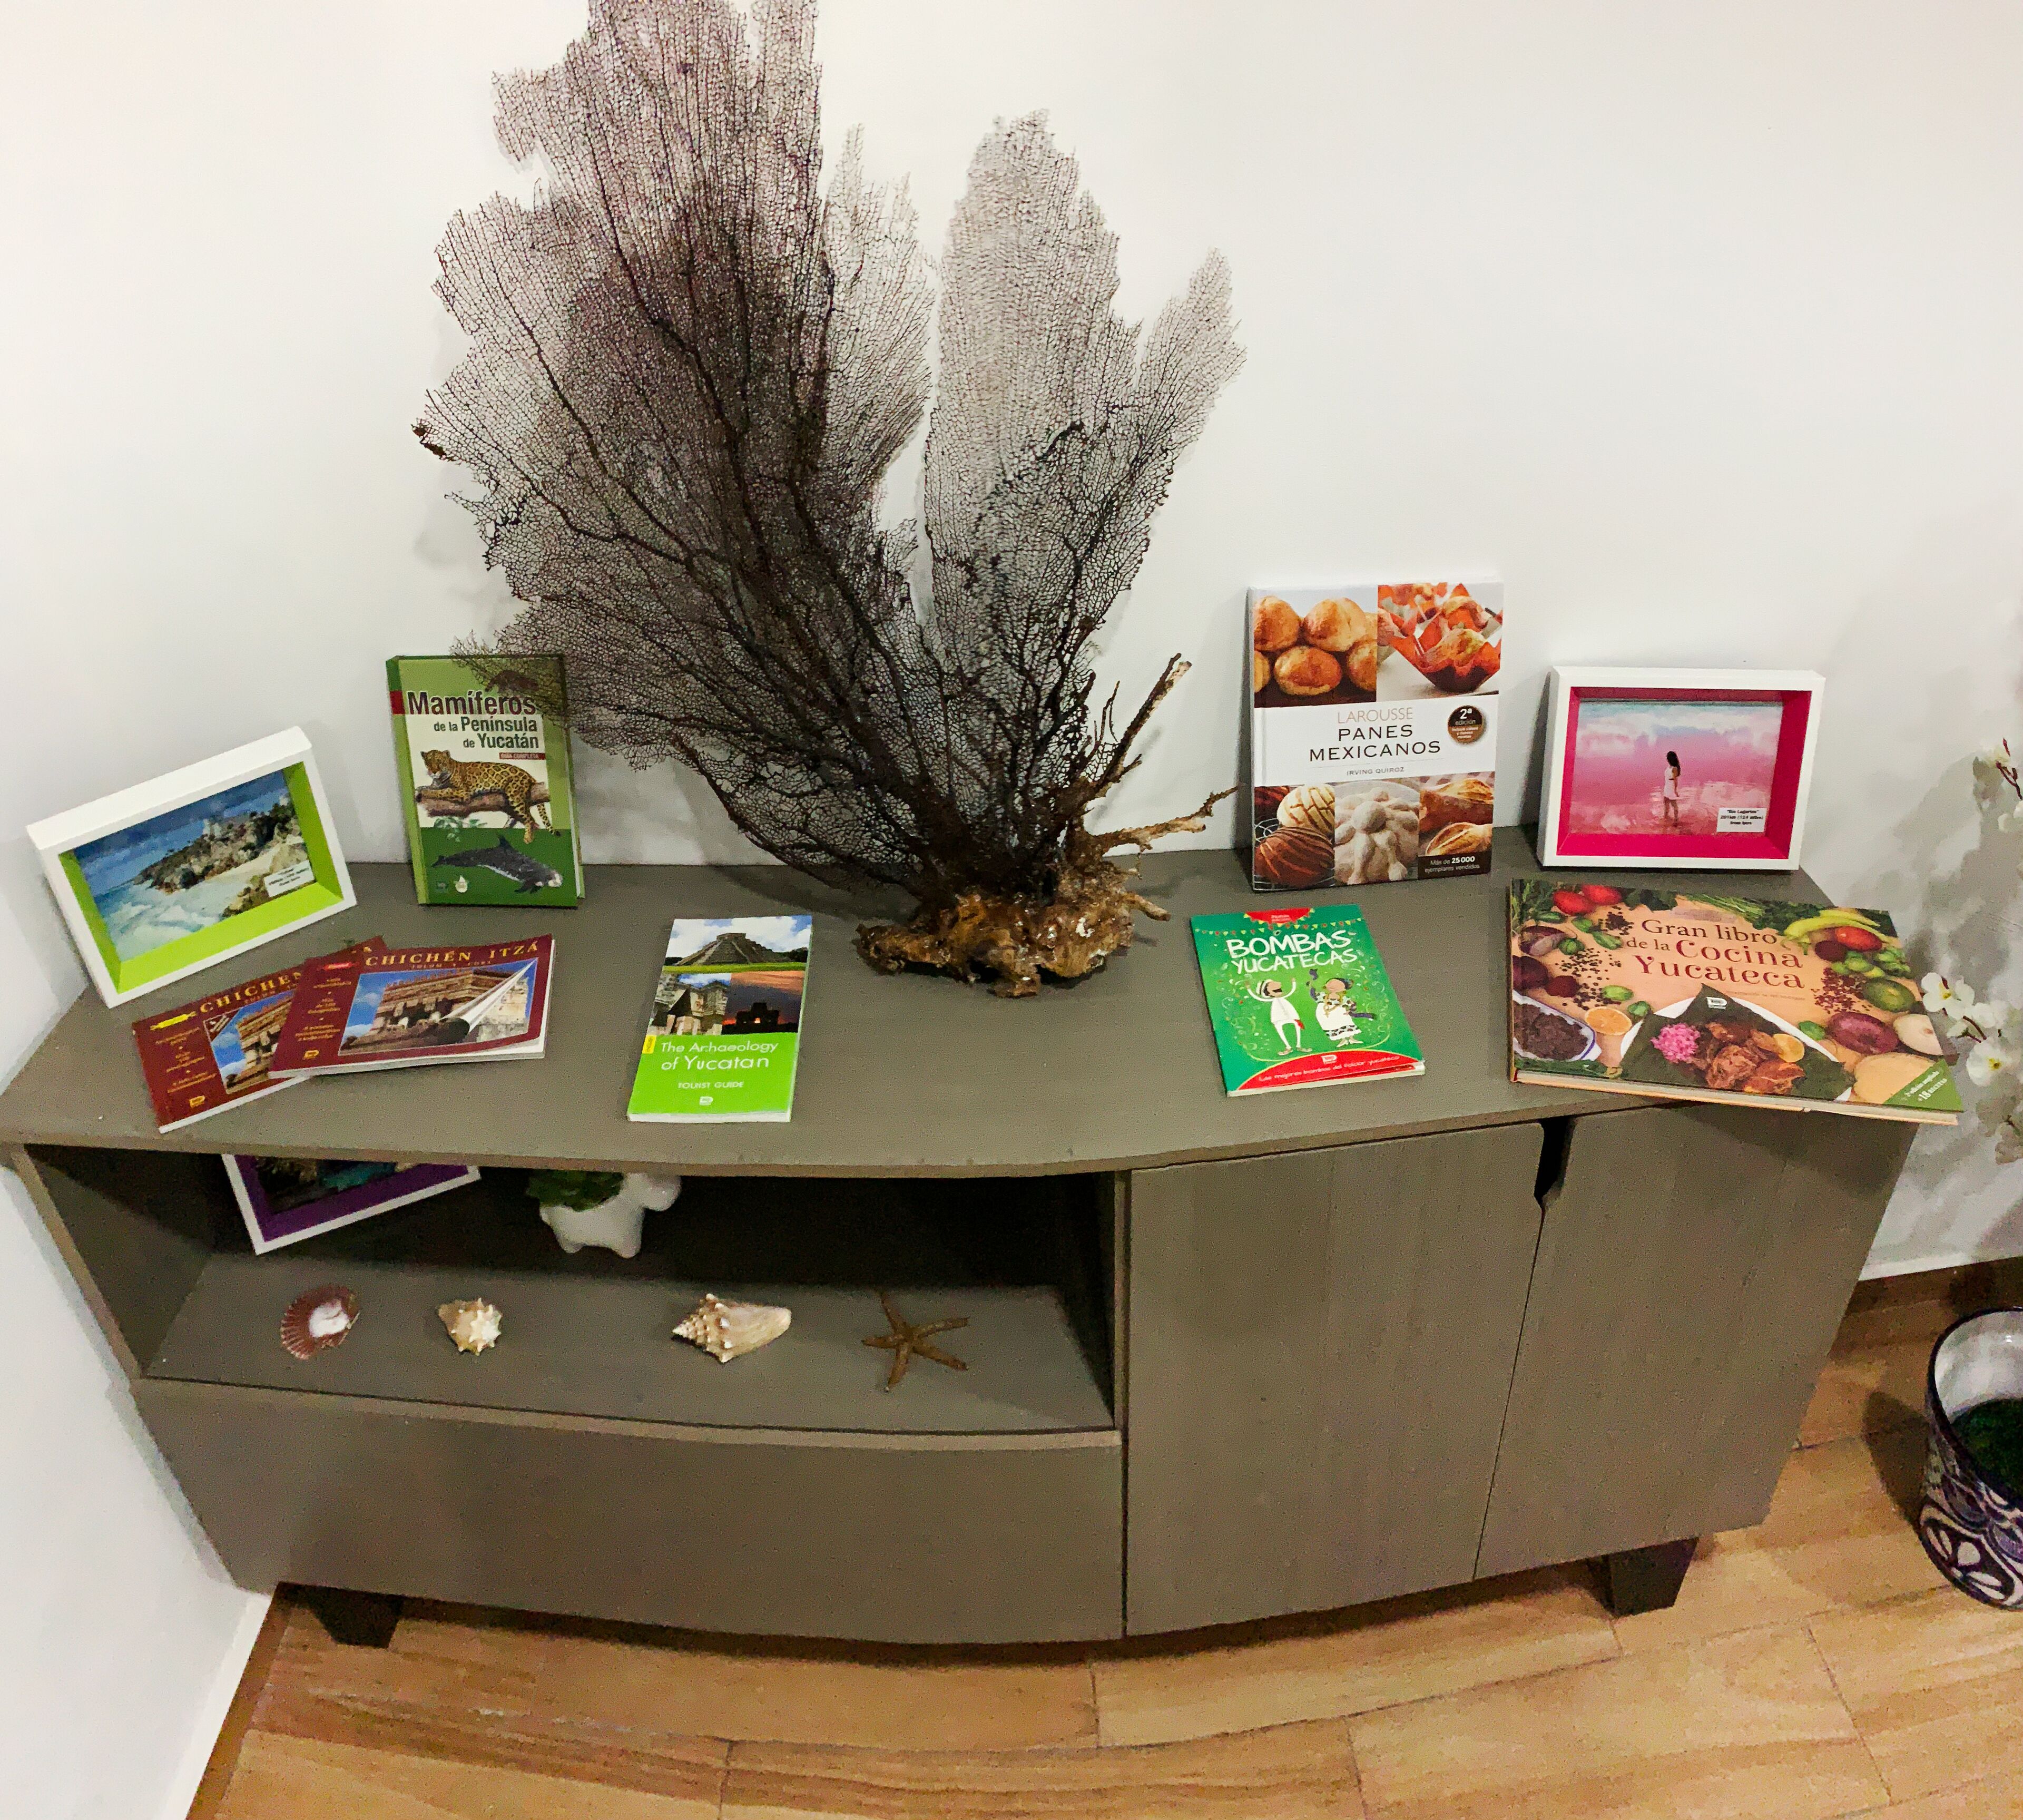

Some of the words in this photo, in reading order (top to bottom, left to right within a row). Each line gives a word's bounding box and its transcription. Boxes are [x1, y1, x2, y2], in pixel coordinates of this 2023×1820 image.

[407, 690, 536, 715] Mamíferos
[434, 721, 446, 731] de
[449, 721, 458, 731] la
[460, 716, 538, 732] Península
[1338, 707, 1413, 723] LAROUSSE
[463, 738, 474, 748] de
[477, 731, 539, 749] Yucatán
[1338, 725, 1413, 741] PANES
[1310, 741, 1440, 762] MEXICANOS
[1642, 919, 1708, 938] Gran
[1715, 925, 1777, 944] libro
[1226, 930, 1351, 958] BOMBAS
[1626, 937, 1647, 949] de
[1654, 939, 1671, 951] la
[1675, 940, 1803, 968] Cocina
[1231, 948, 1357, 974] YUCATECAS
[1634, 955, 1805, 989] Yucateca
[661, 1041, 684, 1053] The
[661, 1056, 679, 1070] of
[684, 1055, 769, 1070] Yucatan
